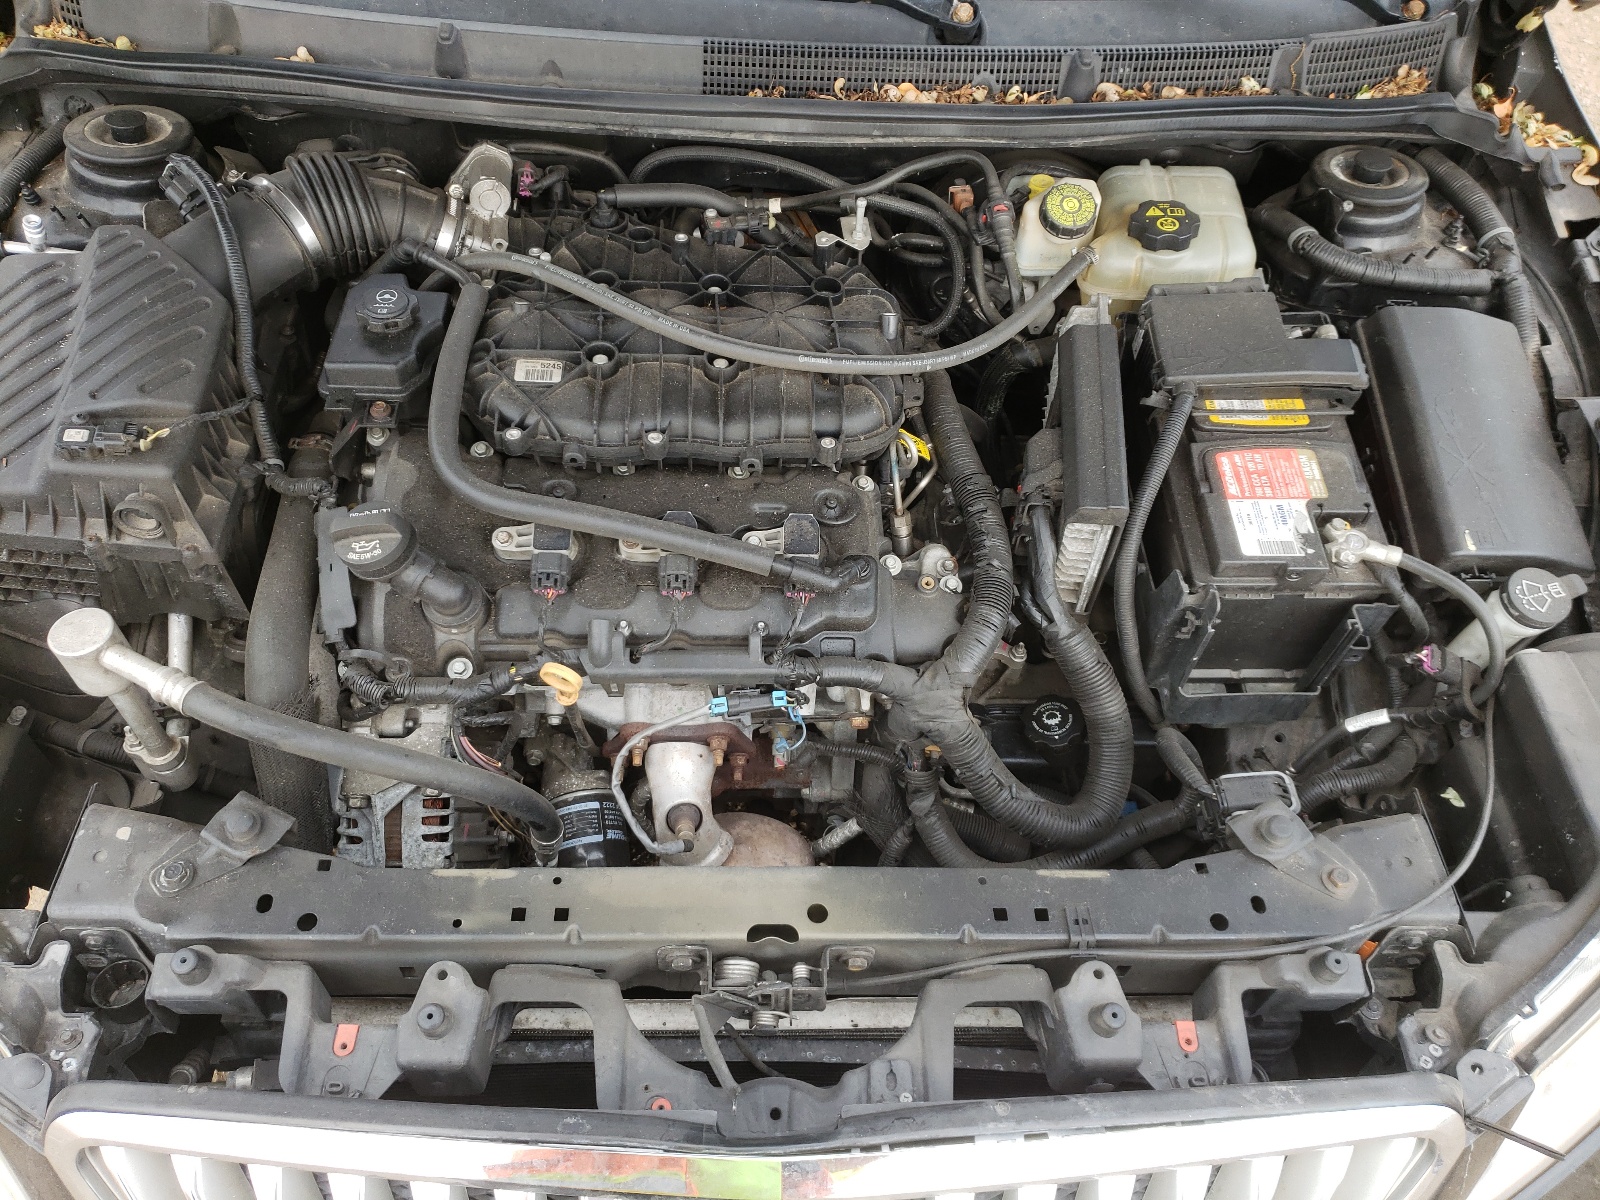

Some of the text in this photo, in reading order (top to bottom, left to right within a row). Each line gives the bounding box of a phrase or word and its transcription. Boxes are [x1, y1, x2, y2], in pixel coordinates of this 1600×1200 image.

[658, 316, 672, 327] MADE
[679, 325, 690, 334] USA
[540, 362, 562, 370] 5245
[347, 552, 360, 560] SAE
